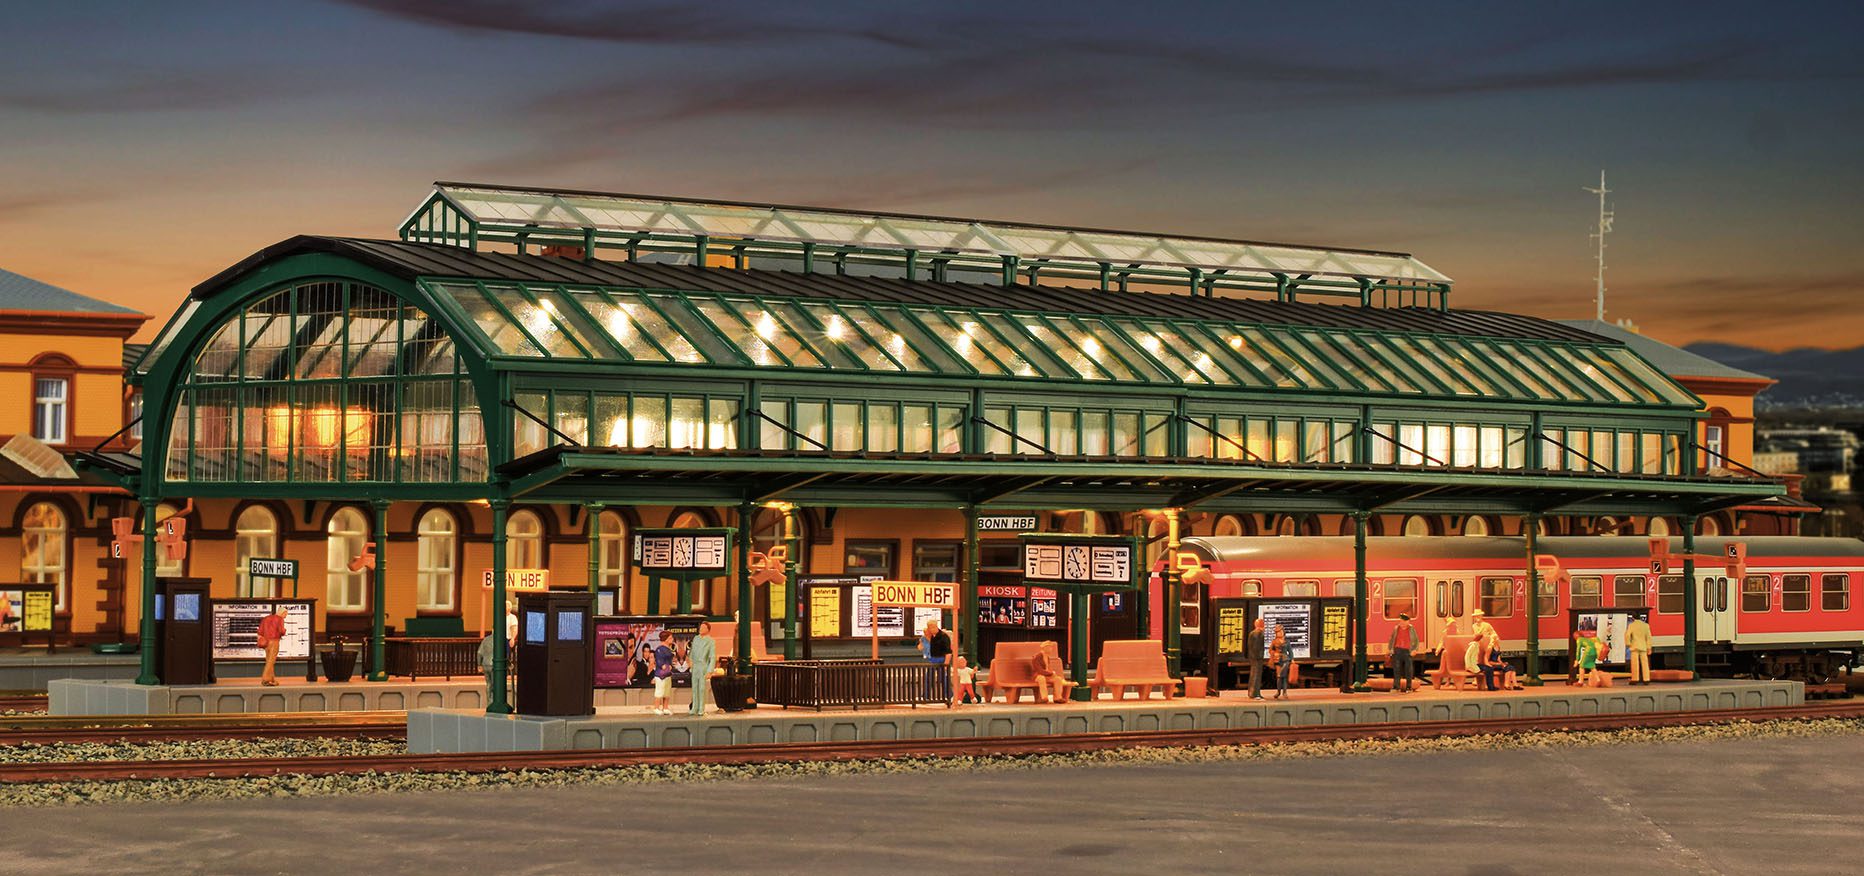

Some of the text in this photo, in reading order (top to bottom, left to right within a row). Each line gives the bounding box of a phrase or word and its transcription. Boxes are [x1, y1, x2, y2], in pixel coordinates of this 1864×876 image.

[978, 518, 1033, 529] BONN HBF
[253, 562, 292, 575] BONN HBF
[485, 572, 541, 587] BN HBF
[1647, 578, 1655, 592] 2
[1773, 577, 1780, 590] 2
[877, 586, 951, 604] BONN HBF
[985, 587, 1019, 595] KIOSK
[1373, 582, 1381, 596] 2
[1516, 581, 1524, 595] 2
